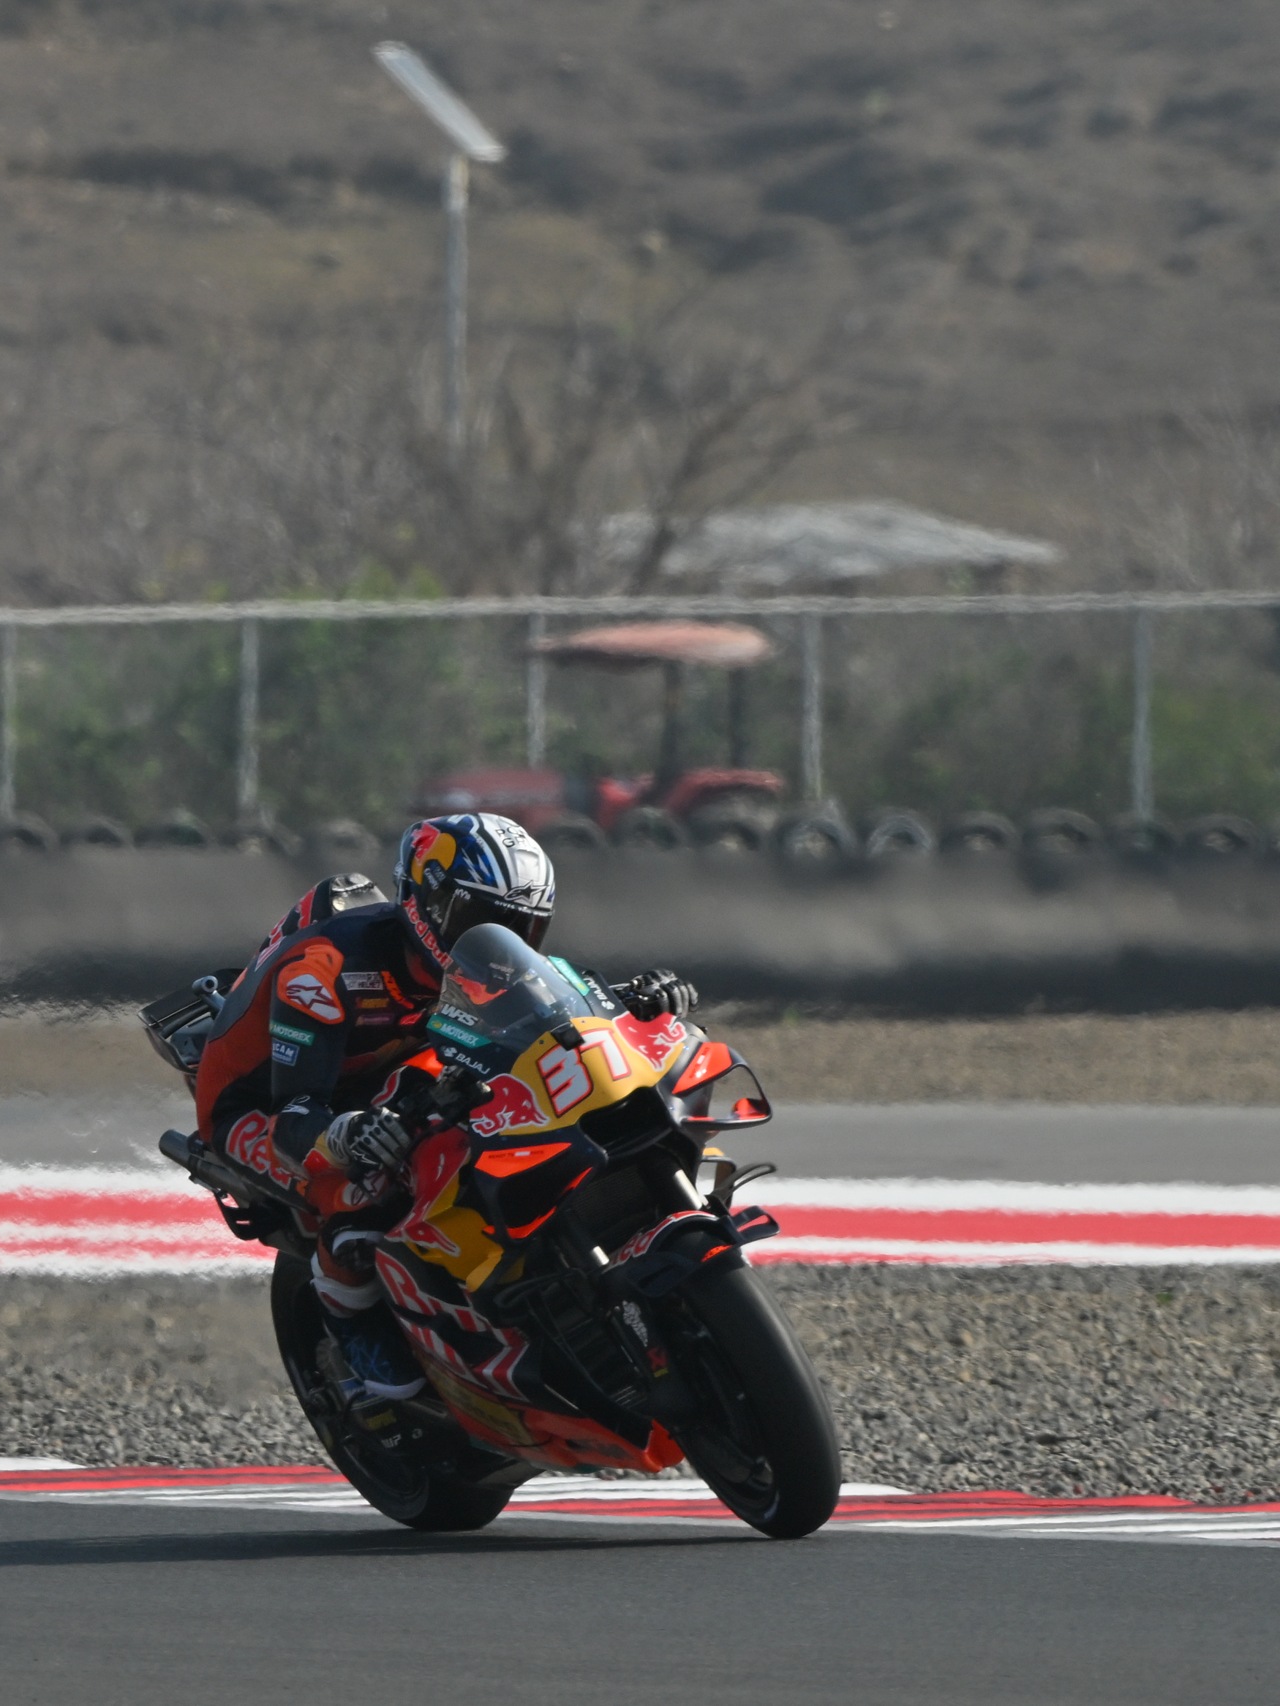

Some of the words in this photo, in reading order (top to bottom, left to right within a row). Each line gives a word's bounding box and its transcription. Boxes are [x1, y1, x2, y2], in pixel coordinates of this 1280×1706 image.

[402, 894, 429, 936] Red
[441, 1003, 479, 1027] WRS
[272, 1024, 312, 1042] MOTOREX
[441, 1023, 479, 1047] MOTOREX
[455, 1052, 491, 1075] BAJAJ
[537, 1027, 632, 1118] 37
